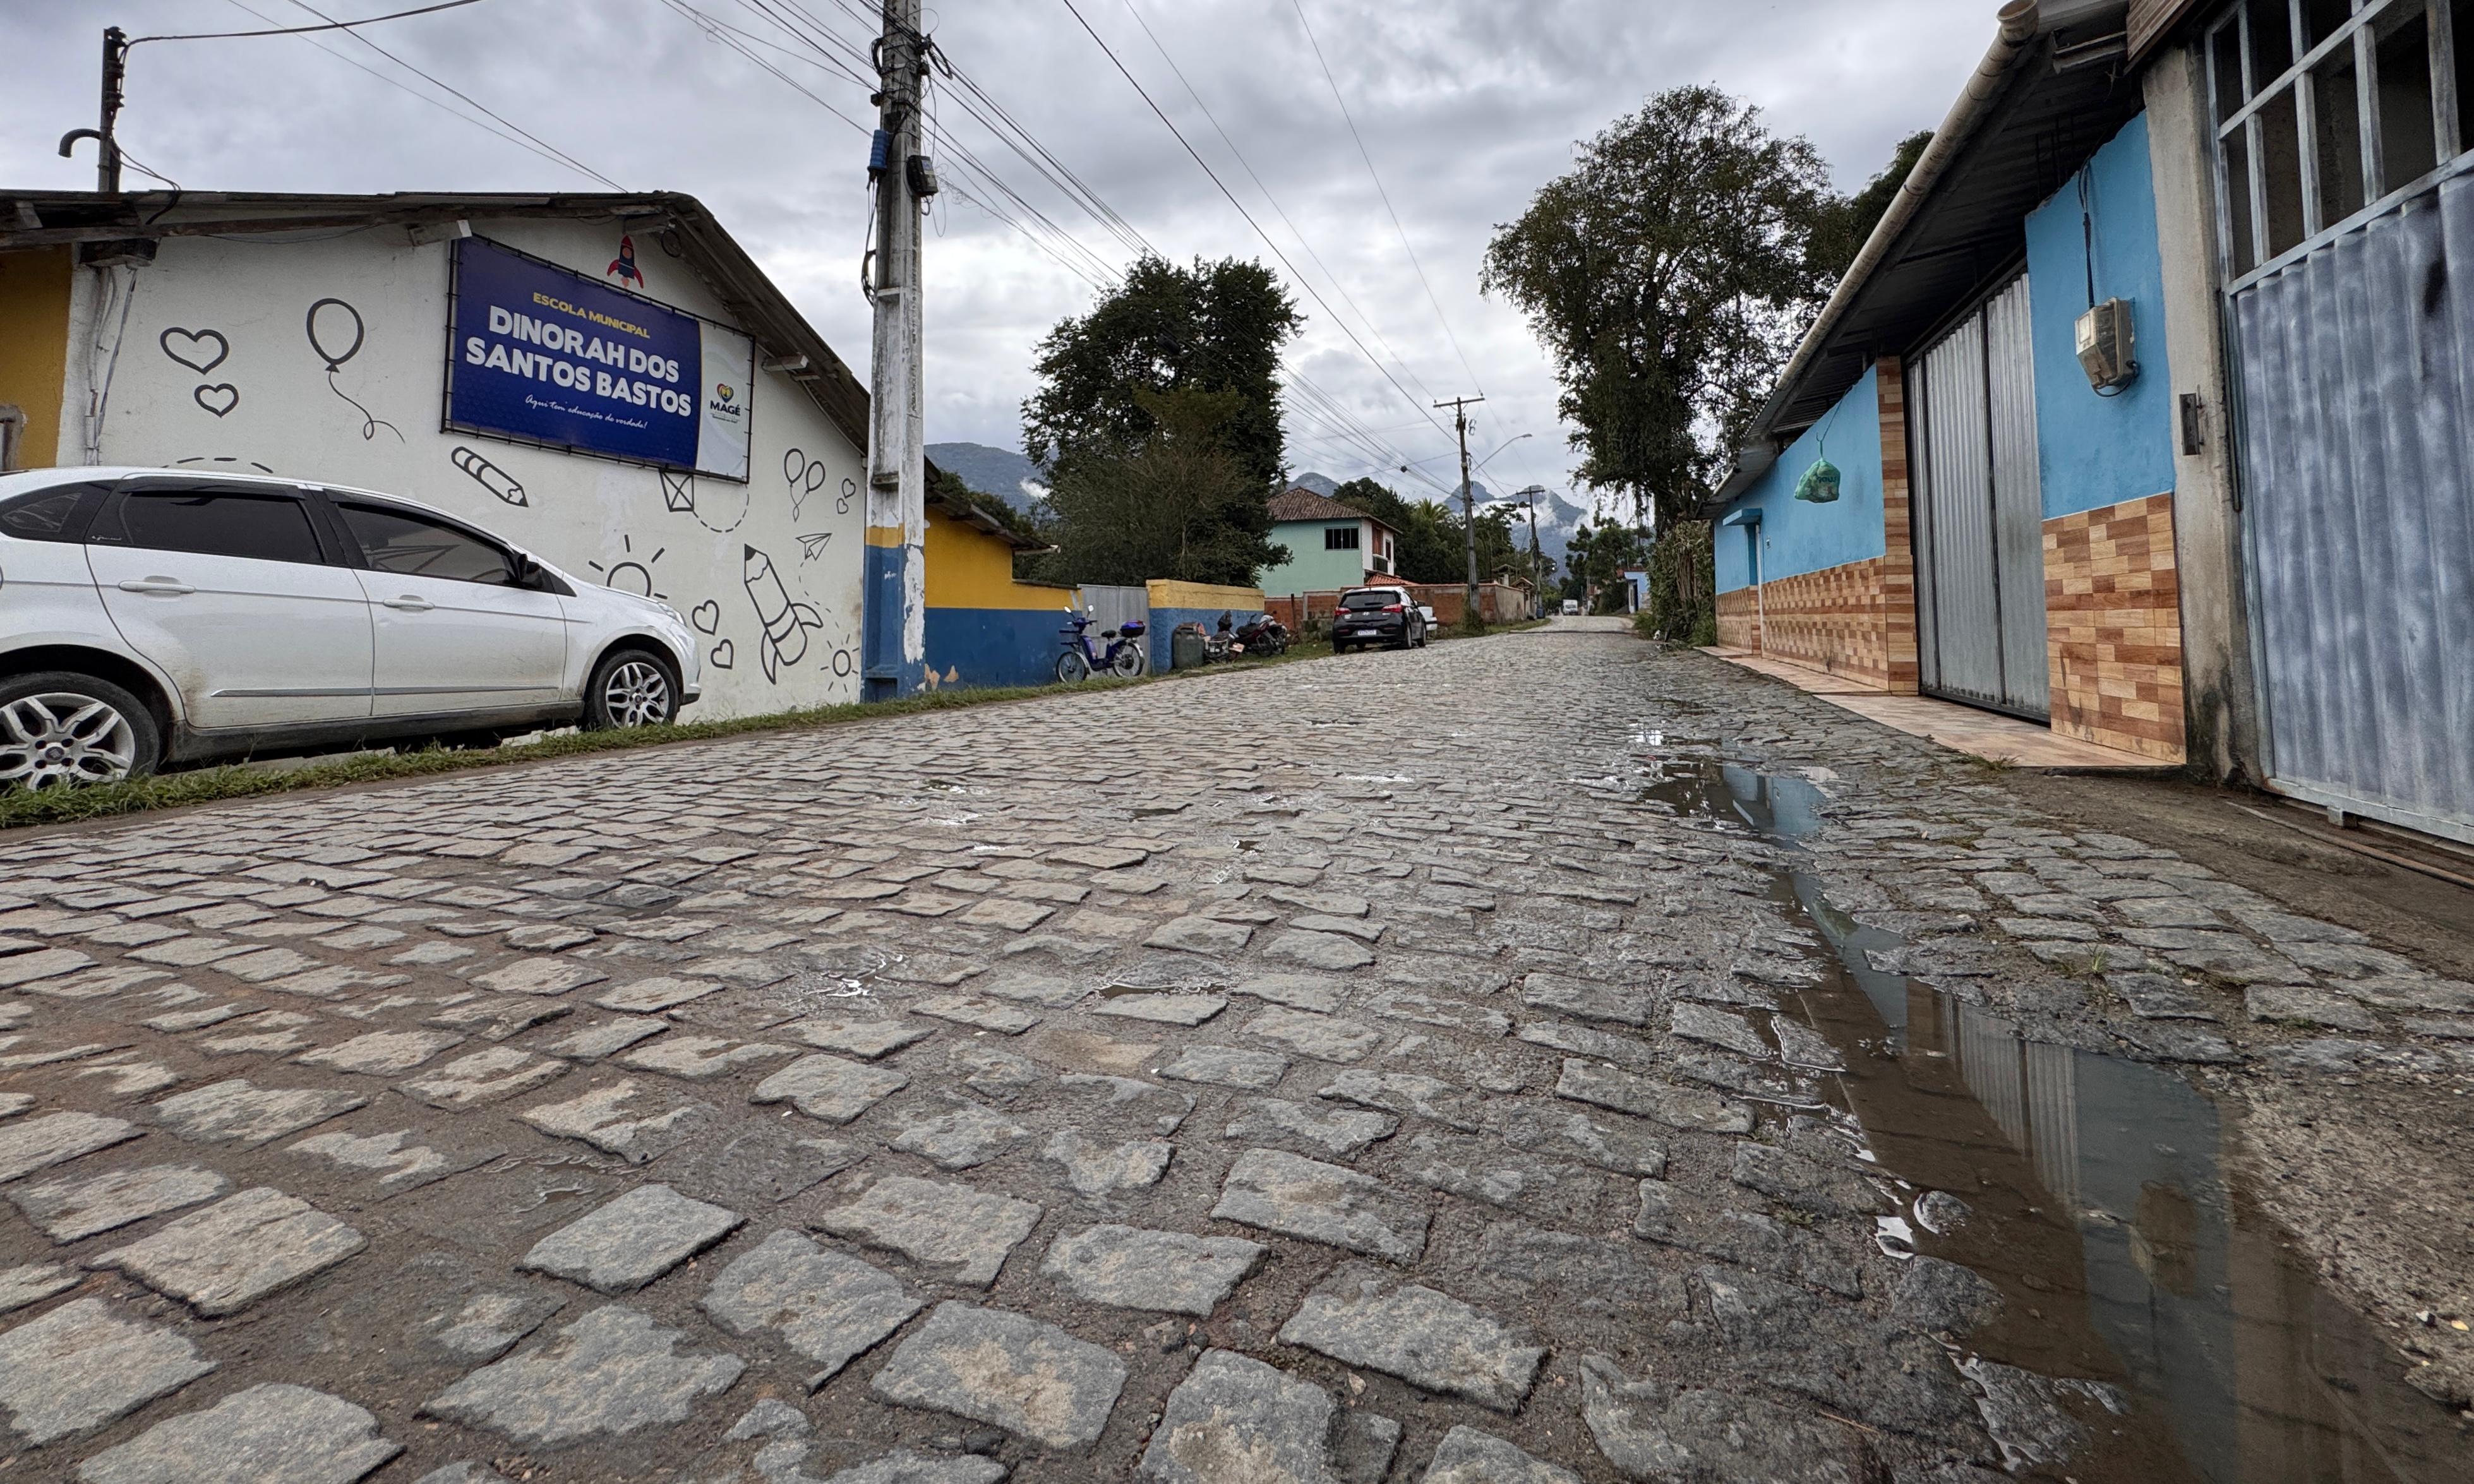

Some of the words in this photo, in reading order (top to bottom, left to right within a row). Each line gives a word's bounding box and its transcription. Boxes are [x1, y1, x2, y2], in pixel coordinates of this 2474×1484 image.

[533, 292, 587, 318] ESCOLA
[589, 311, 651, 338] MUNICIPAL
[489, 305, 625, 368] DINORAH
[629, 348, 679, 383] DOS
[466, 337, 591, 392] SANTOS
[596, 371, 691, 417] BASTOS
[525, 394, 548, 409] Aqui
[567, 405, 603, 419] educação
[604, 413, 615, 422] de
[616, 417, 649, 429] verdade!
[710, 400, 740, 416] MAGÉ
